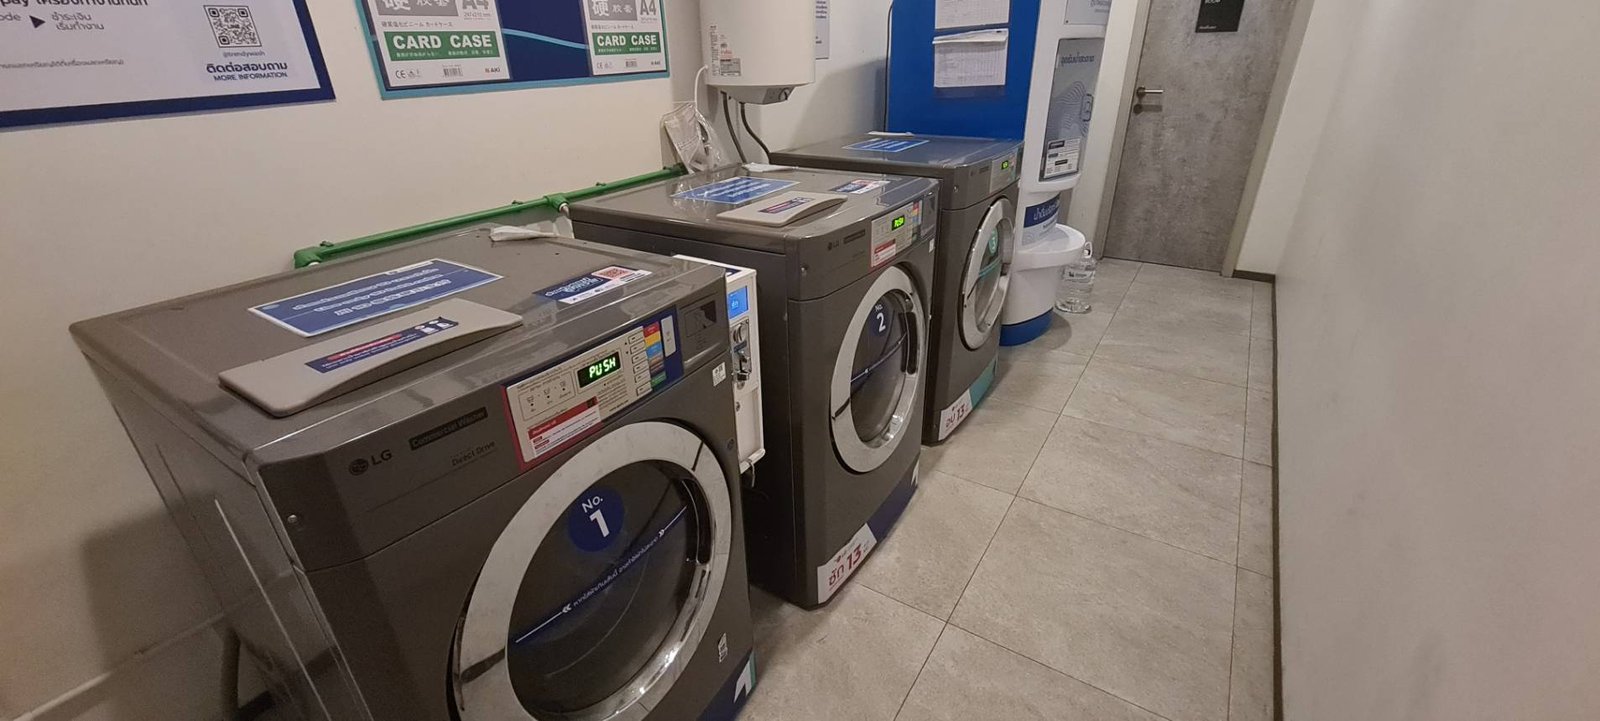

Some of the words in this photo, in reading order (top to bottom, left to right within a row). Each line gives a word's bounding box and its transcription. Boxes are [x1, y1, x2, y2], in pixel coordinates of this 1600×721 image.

[640, 0, 657, 16] A4
[393, 35, 442, 49] CARD
[449, 35, 493, 48] CASE
[597, 35, 627, 46] CARD
[631, 34, 657, 45] CASE
[206, 61, 288, 73] ติดต่อสอบถาม
[213, 73, 238, 82] MORE
[239, 71, 288, 81] INFORMATION
[876, 312, 886, 332] 2
[589, 357, 616, 379] PUSH
[371, 449, 393, 466] LG
[581, 495, 604, 513] No.
[589, 508, 610, 538] 1
[847, 543, 863, 570] 13
